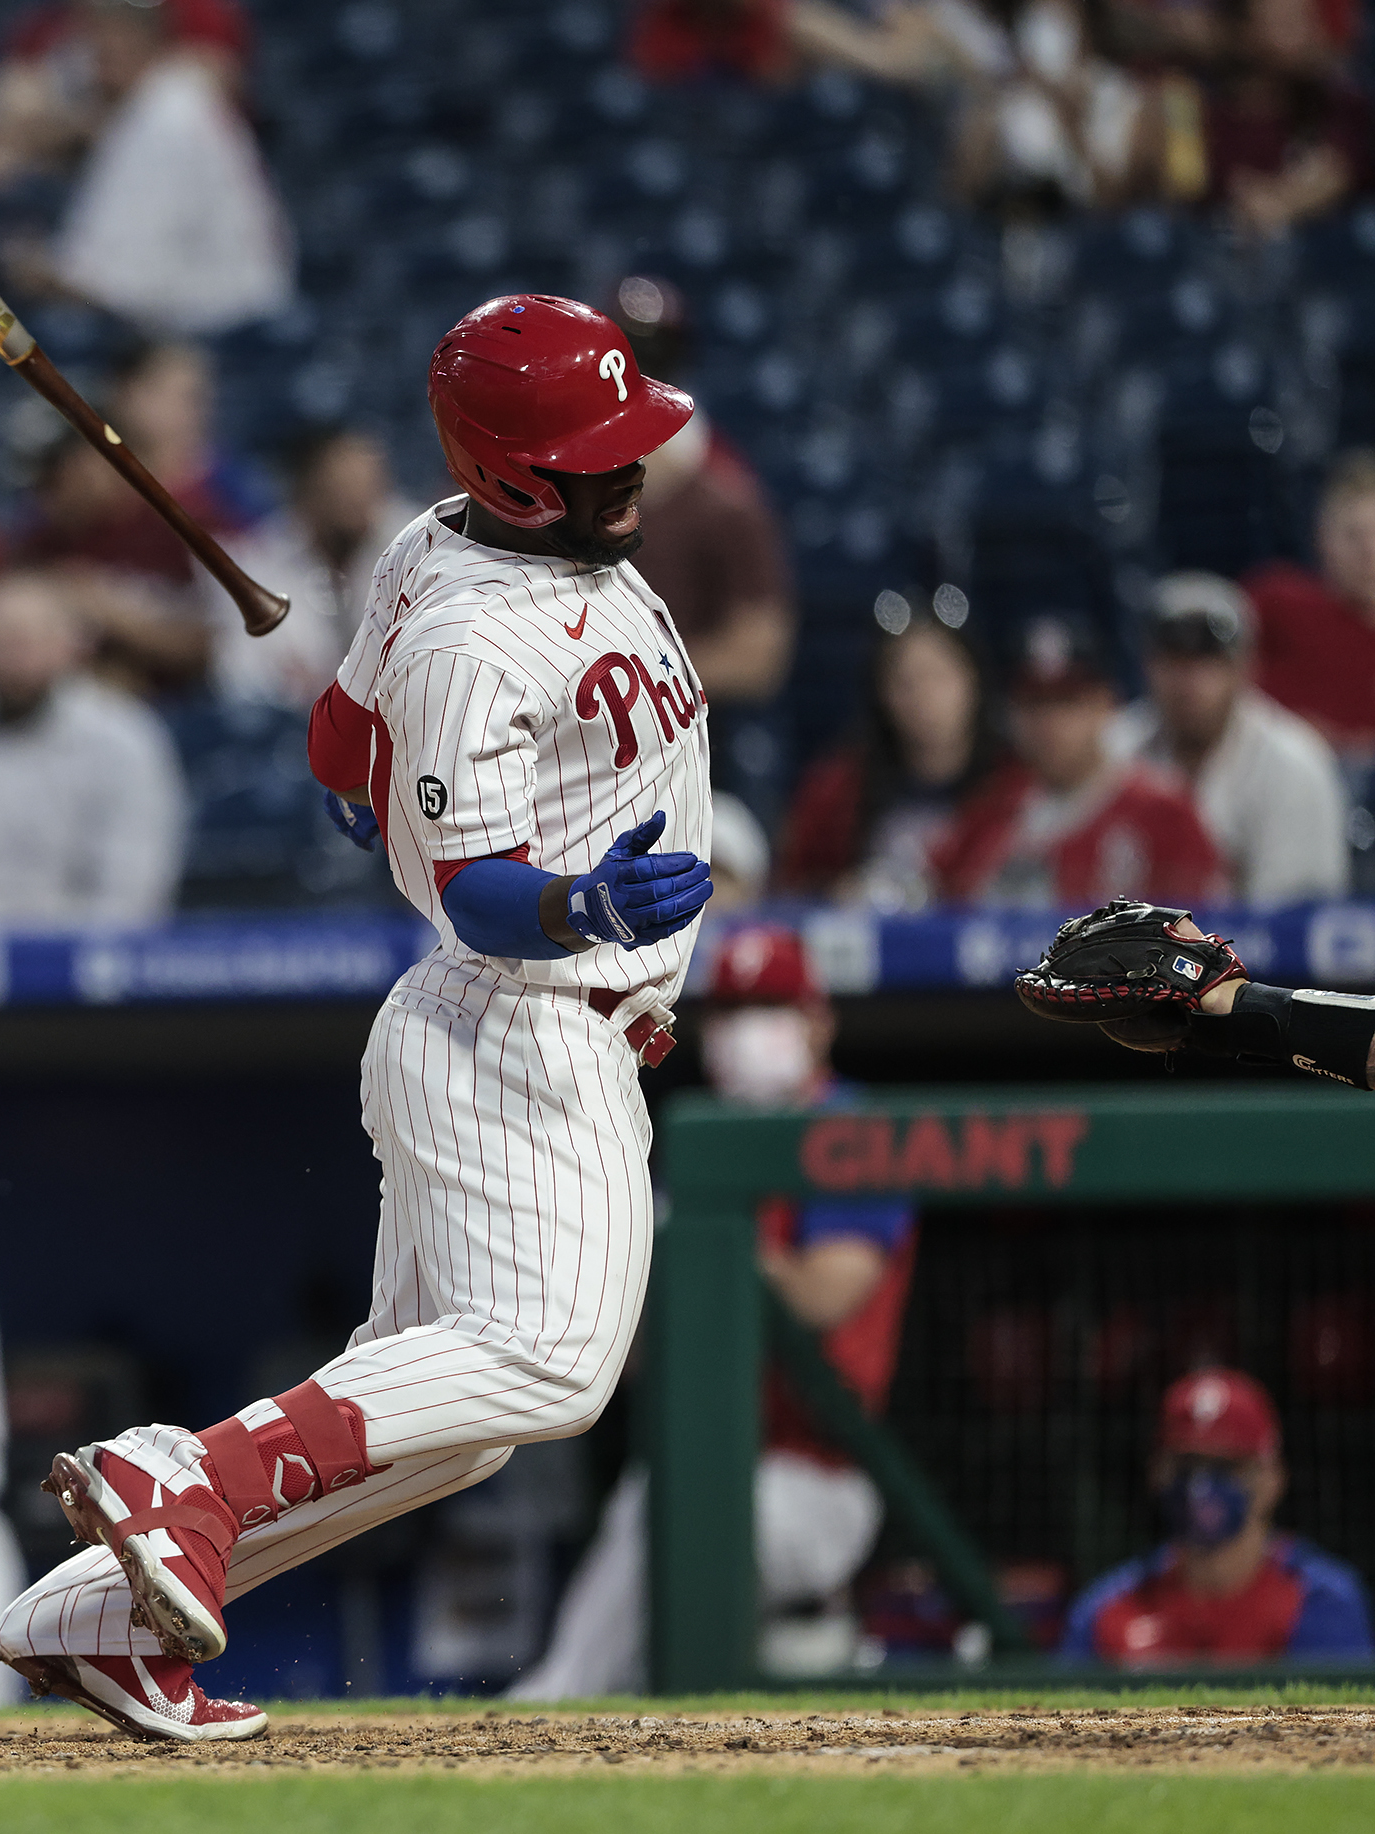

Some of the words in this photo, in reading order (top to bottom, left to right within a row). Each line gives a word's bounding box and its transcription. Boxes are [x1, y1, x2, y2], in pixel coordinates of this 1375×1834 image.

[599, 349, 628, 402] P
[575, 652, 708, 769] Phi
[420, 782, 442, 814] 15
[800, 1114, 1088, 1190] GIANT
